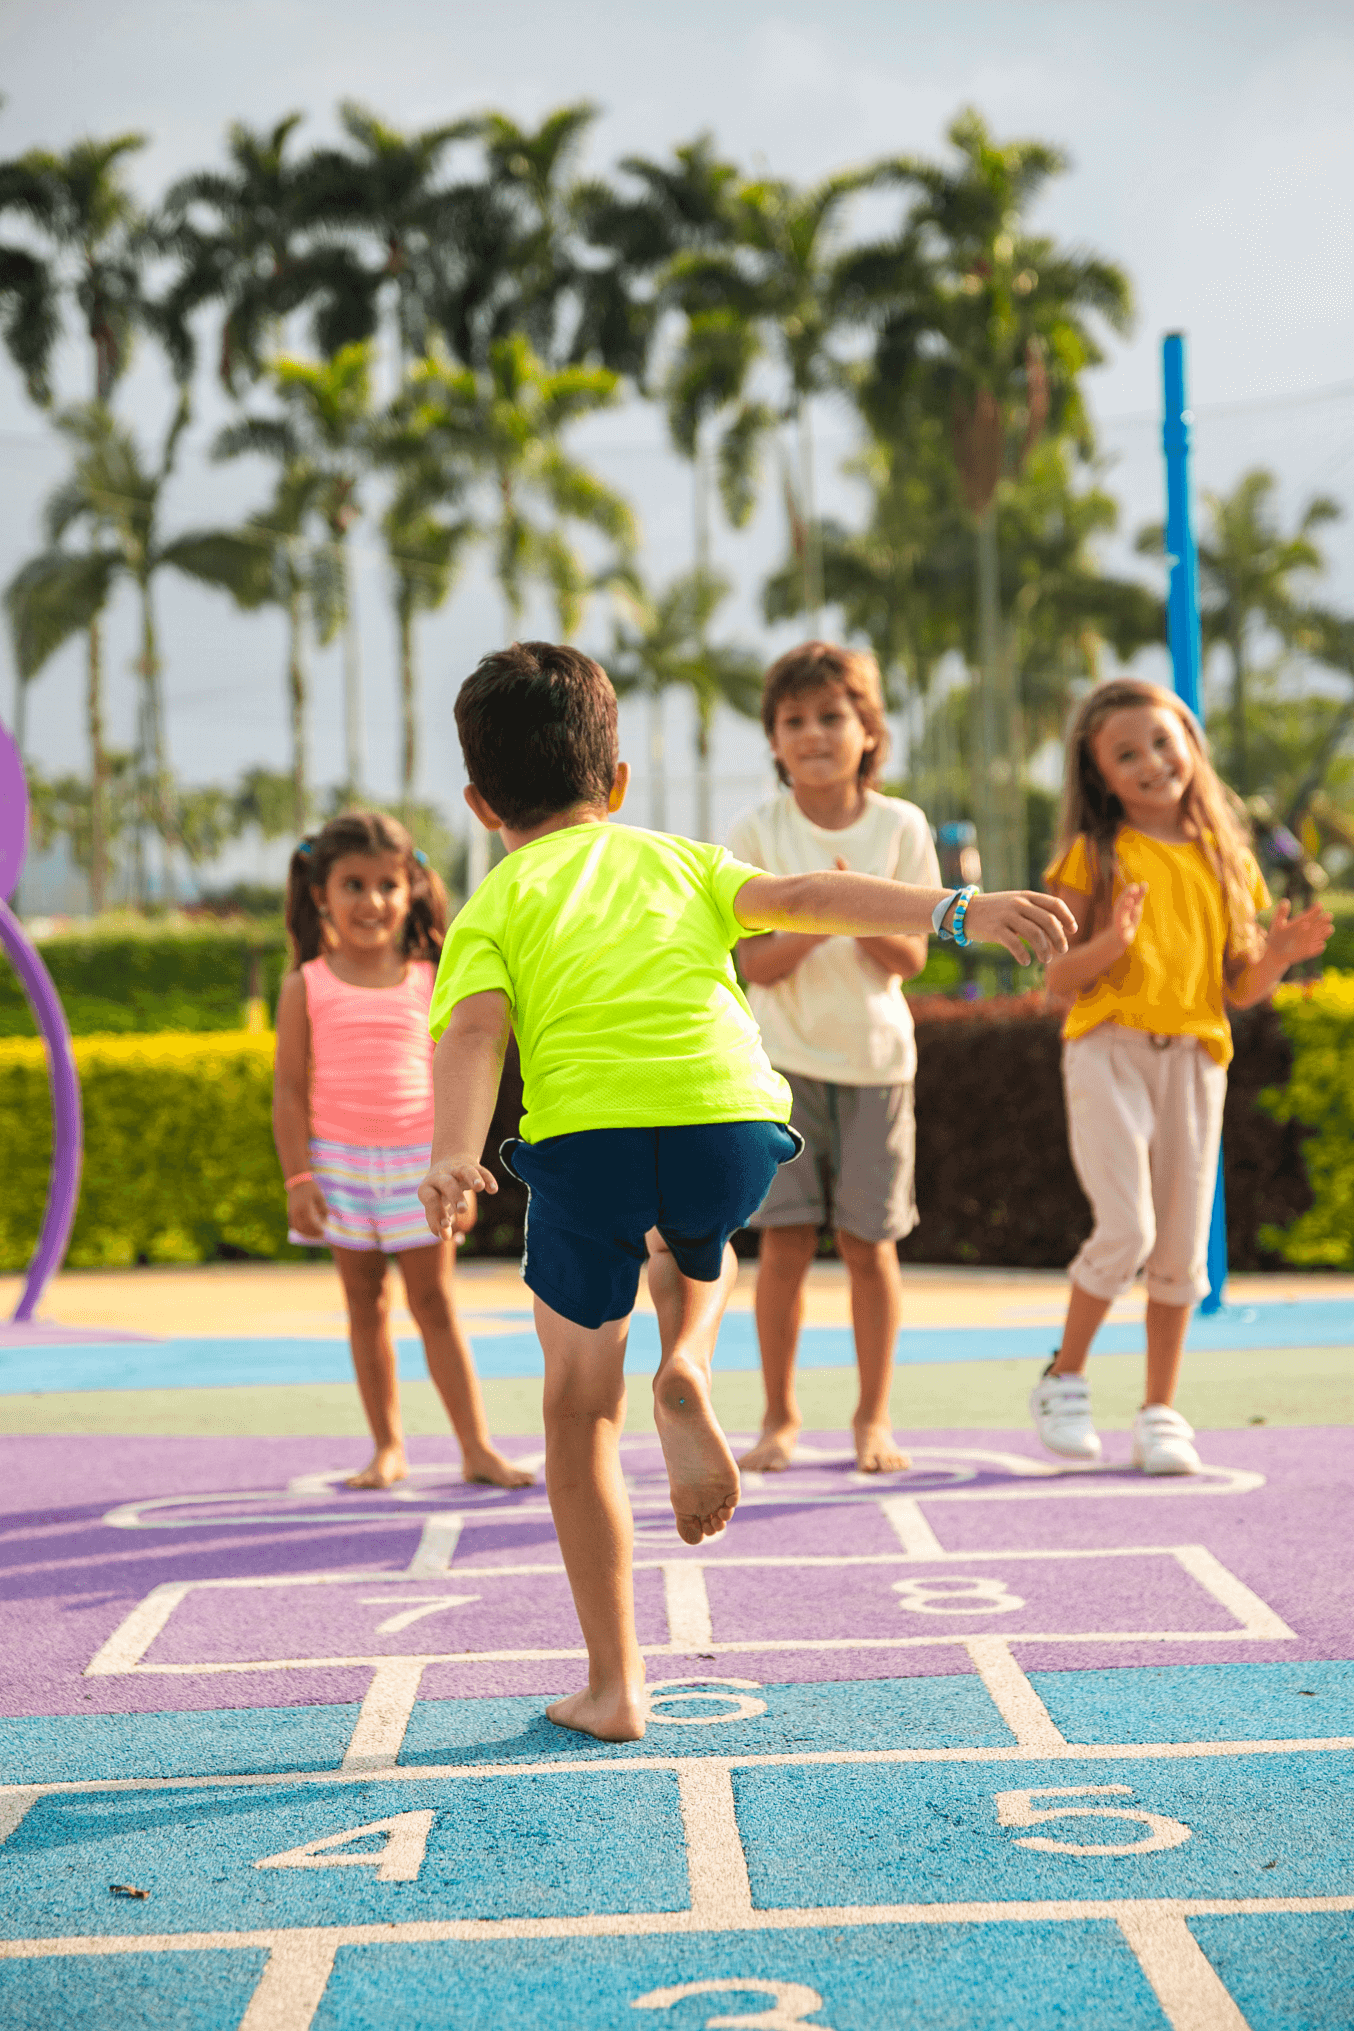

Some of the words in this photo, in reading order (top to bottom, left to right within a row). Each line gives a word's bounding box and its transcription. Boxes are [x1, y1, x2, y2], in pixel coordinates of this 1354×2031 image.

[359, 1594, 483, 1635] 7
[892, 1576, 1026, 1615] 8
[644, 1676, 768, 1725] 6
[253, 1808, 437, 1882] 4
[996, 1784, 1193, 1857] 5
